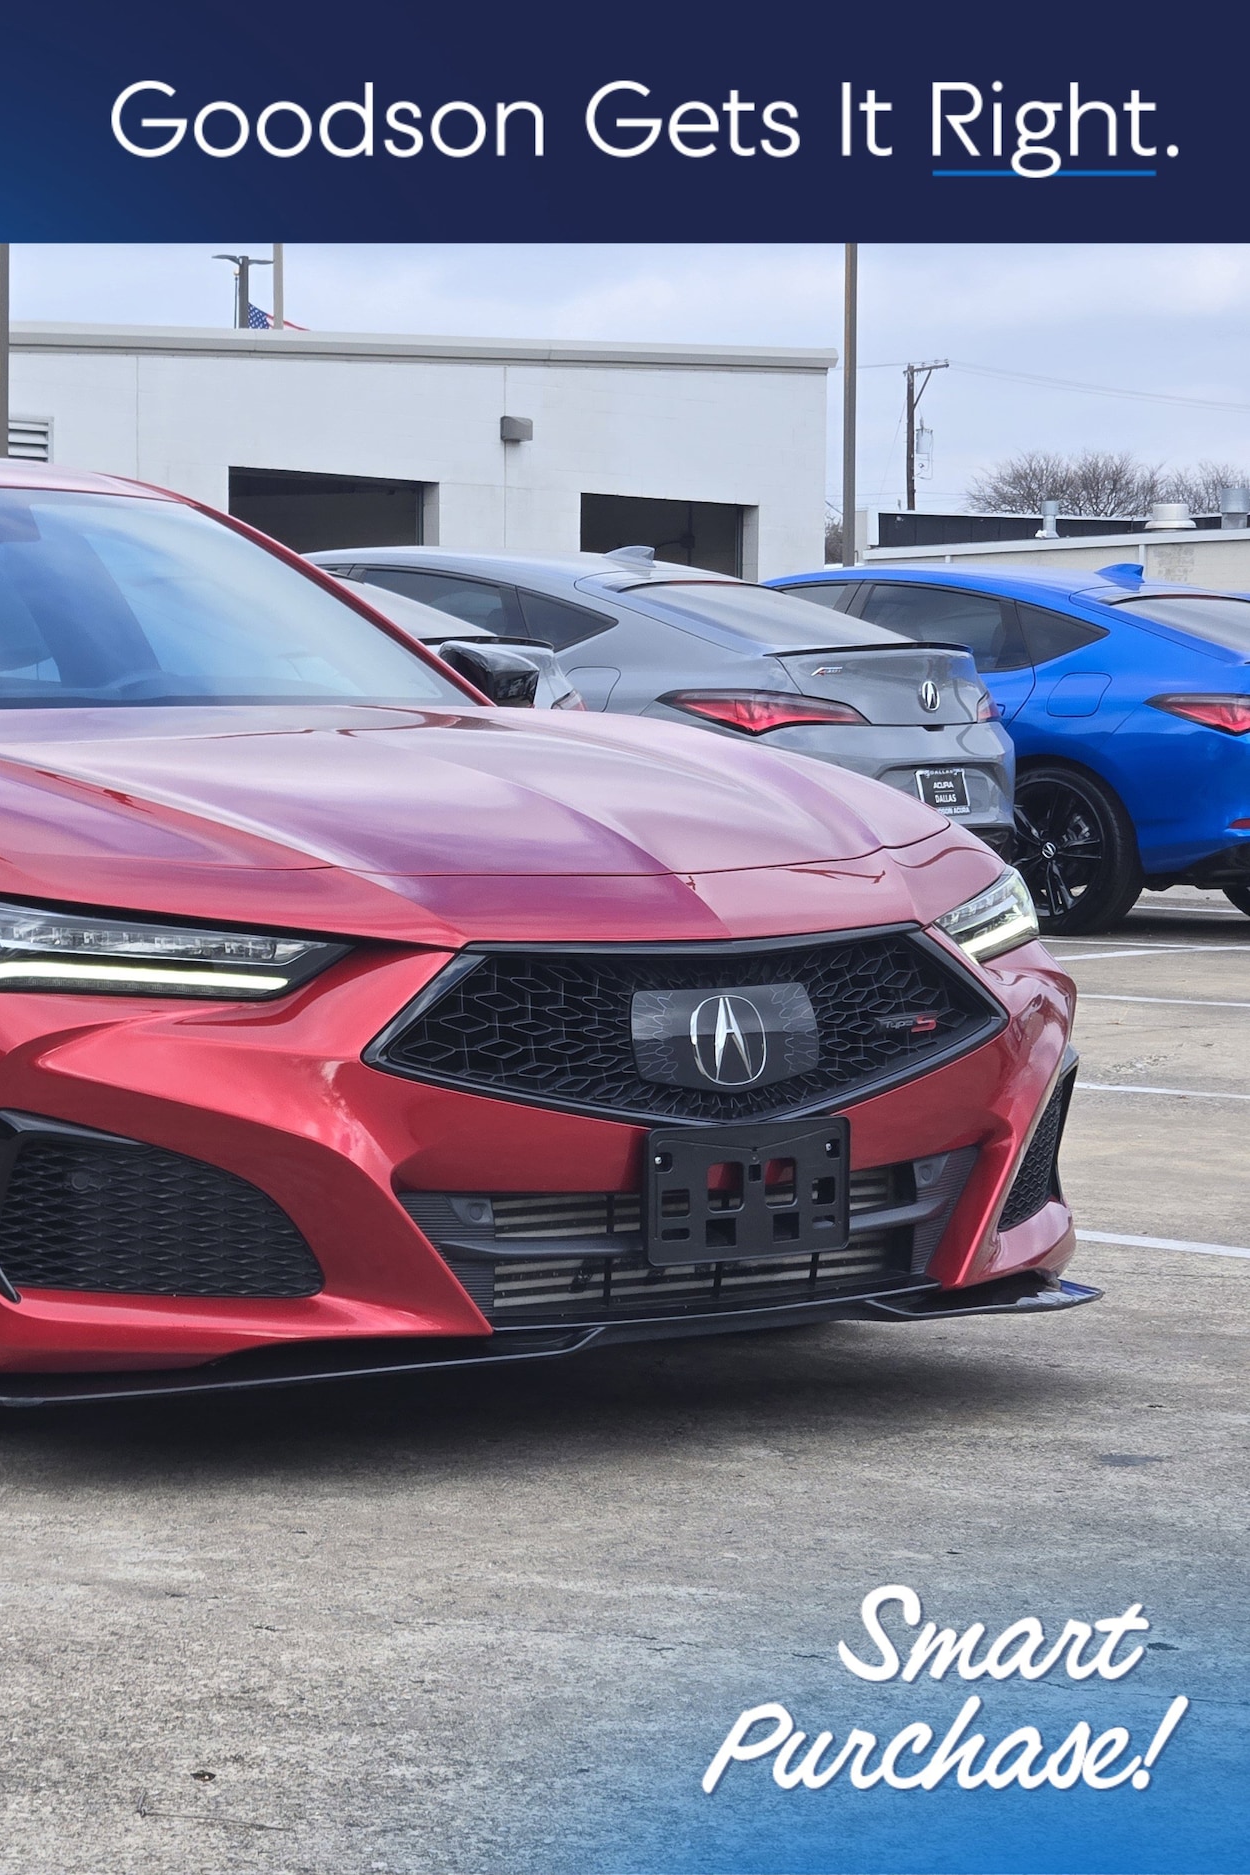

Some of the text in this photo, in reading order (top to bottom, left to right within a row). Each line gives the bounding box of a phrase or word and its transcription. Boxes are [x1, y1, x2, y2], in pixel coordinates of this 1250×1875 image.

[933, 781, 954, 789] ACURA
[934, 794, 957, 803] DALLAS
[911, 1014, 937, 1033] S
